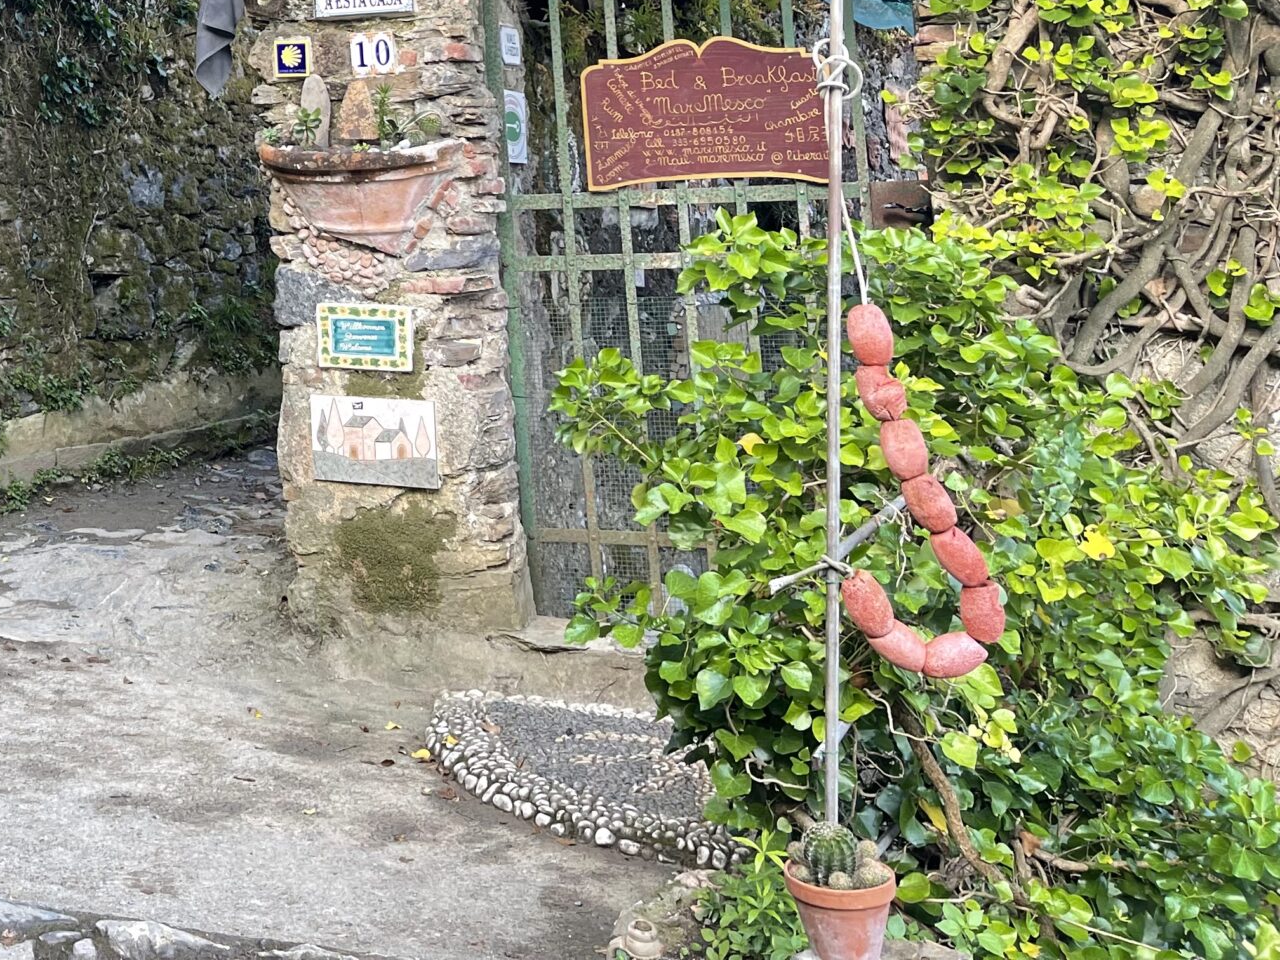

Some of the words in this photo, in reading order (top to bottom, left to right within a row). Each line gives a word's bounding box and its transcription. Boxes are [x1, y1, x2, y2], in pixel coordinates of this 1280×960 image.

[356, 39, 390, 68] 10
[640, 70, 680, 93] Bed
[694, 75, 708, 90] &
[764, 107, 822, 131] Chambre
[663, 125, 734, 137] 0187-808154
[596, 161, 629, 184] Rooms
